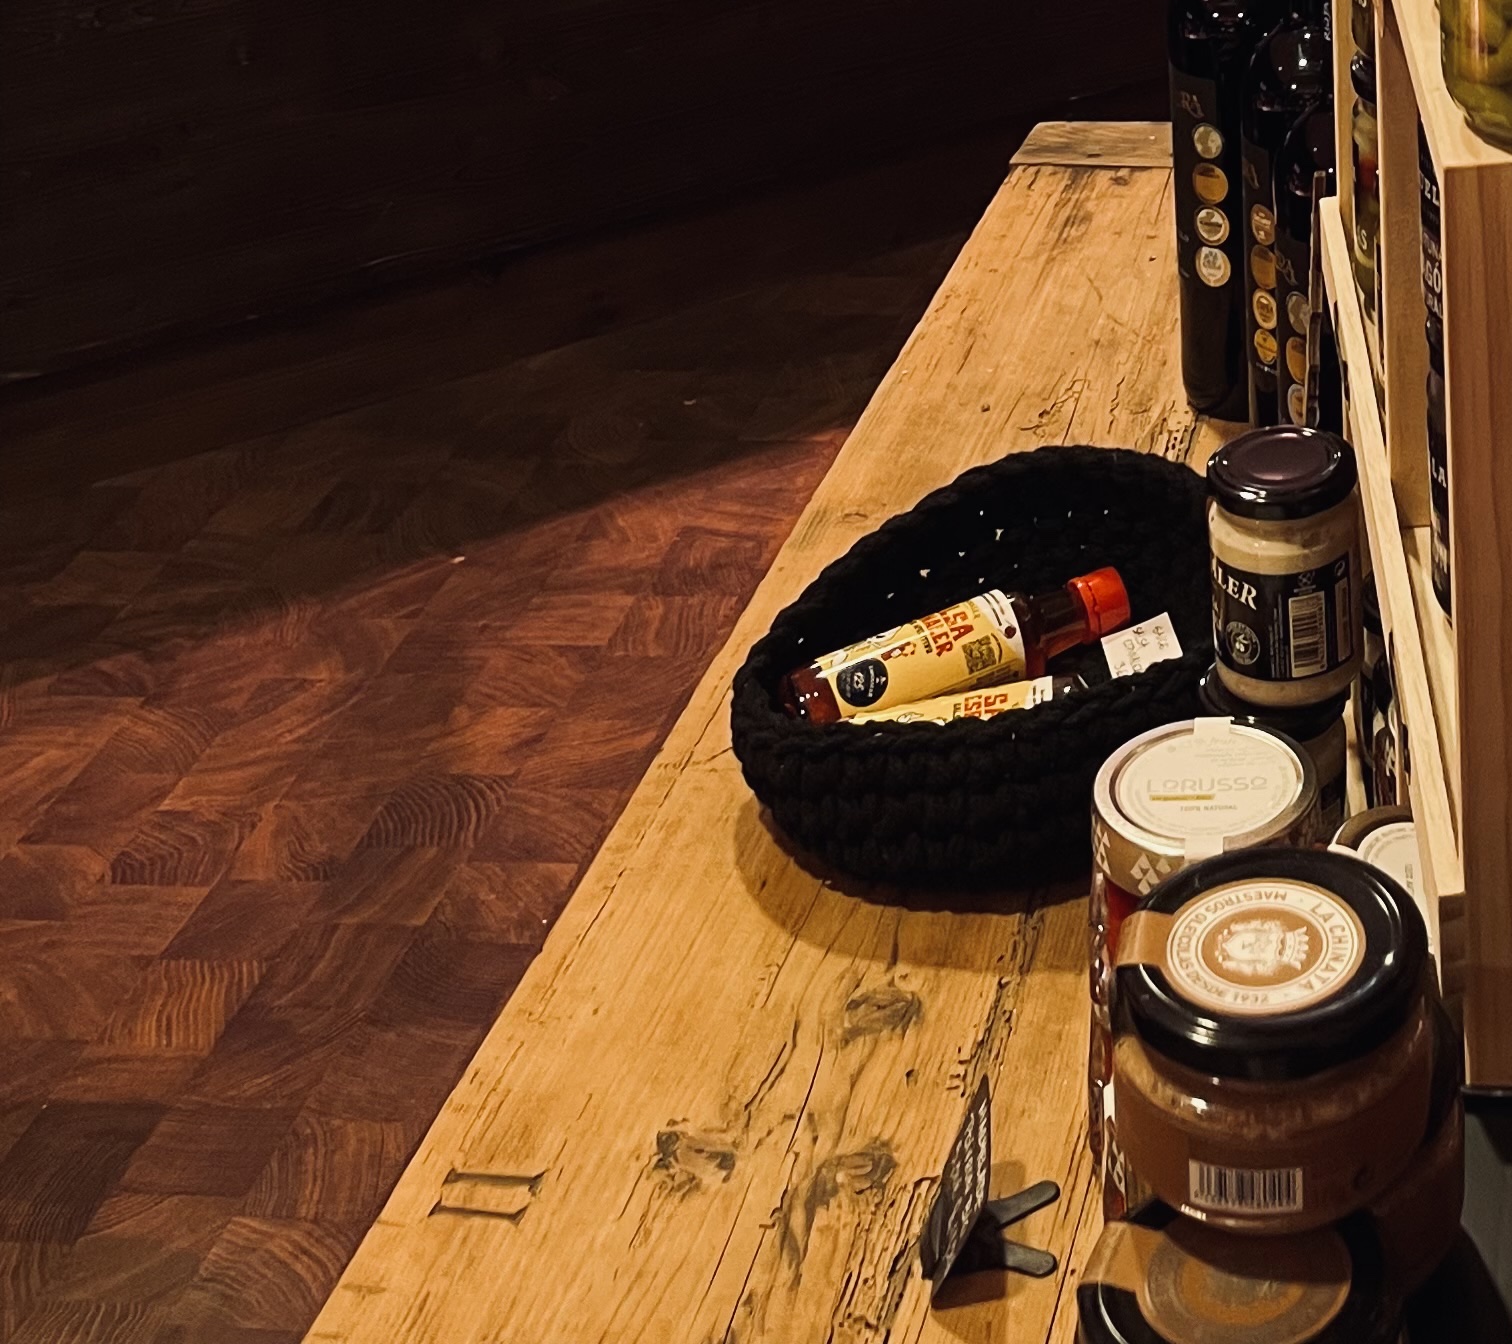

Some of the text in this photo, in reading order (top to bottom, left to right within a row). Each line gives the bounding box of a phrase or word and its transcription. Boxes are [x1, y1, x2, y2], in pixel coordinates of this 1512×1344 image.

[1204, 890, 1288, 914] MAESTROS
[1299, 901, 1349, 992] LA CHINATA
